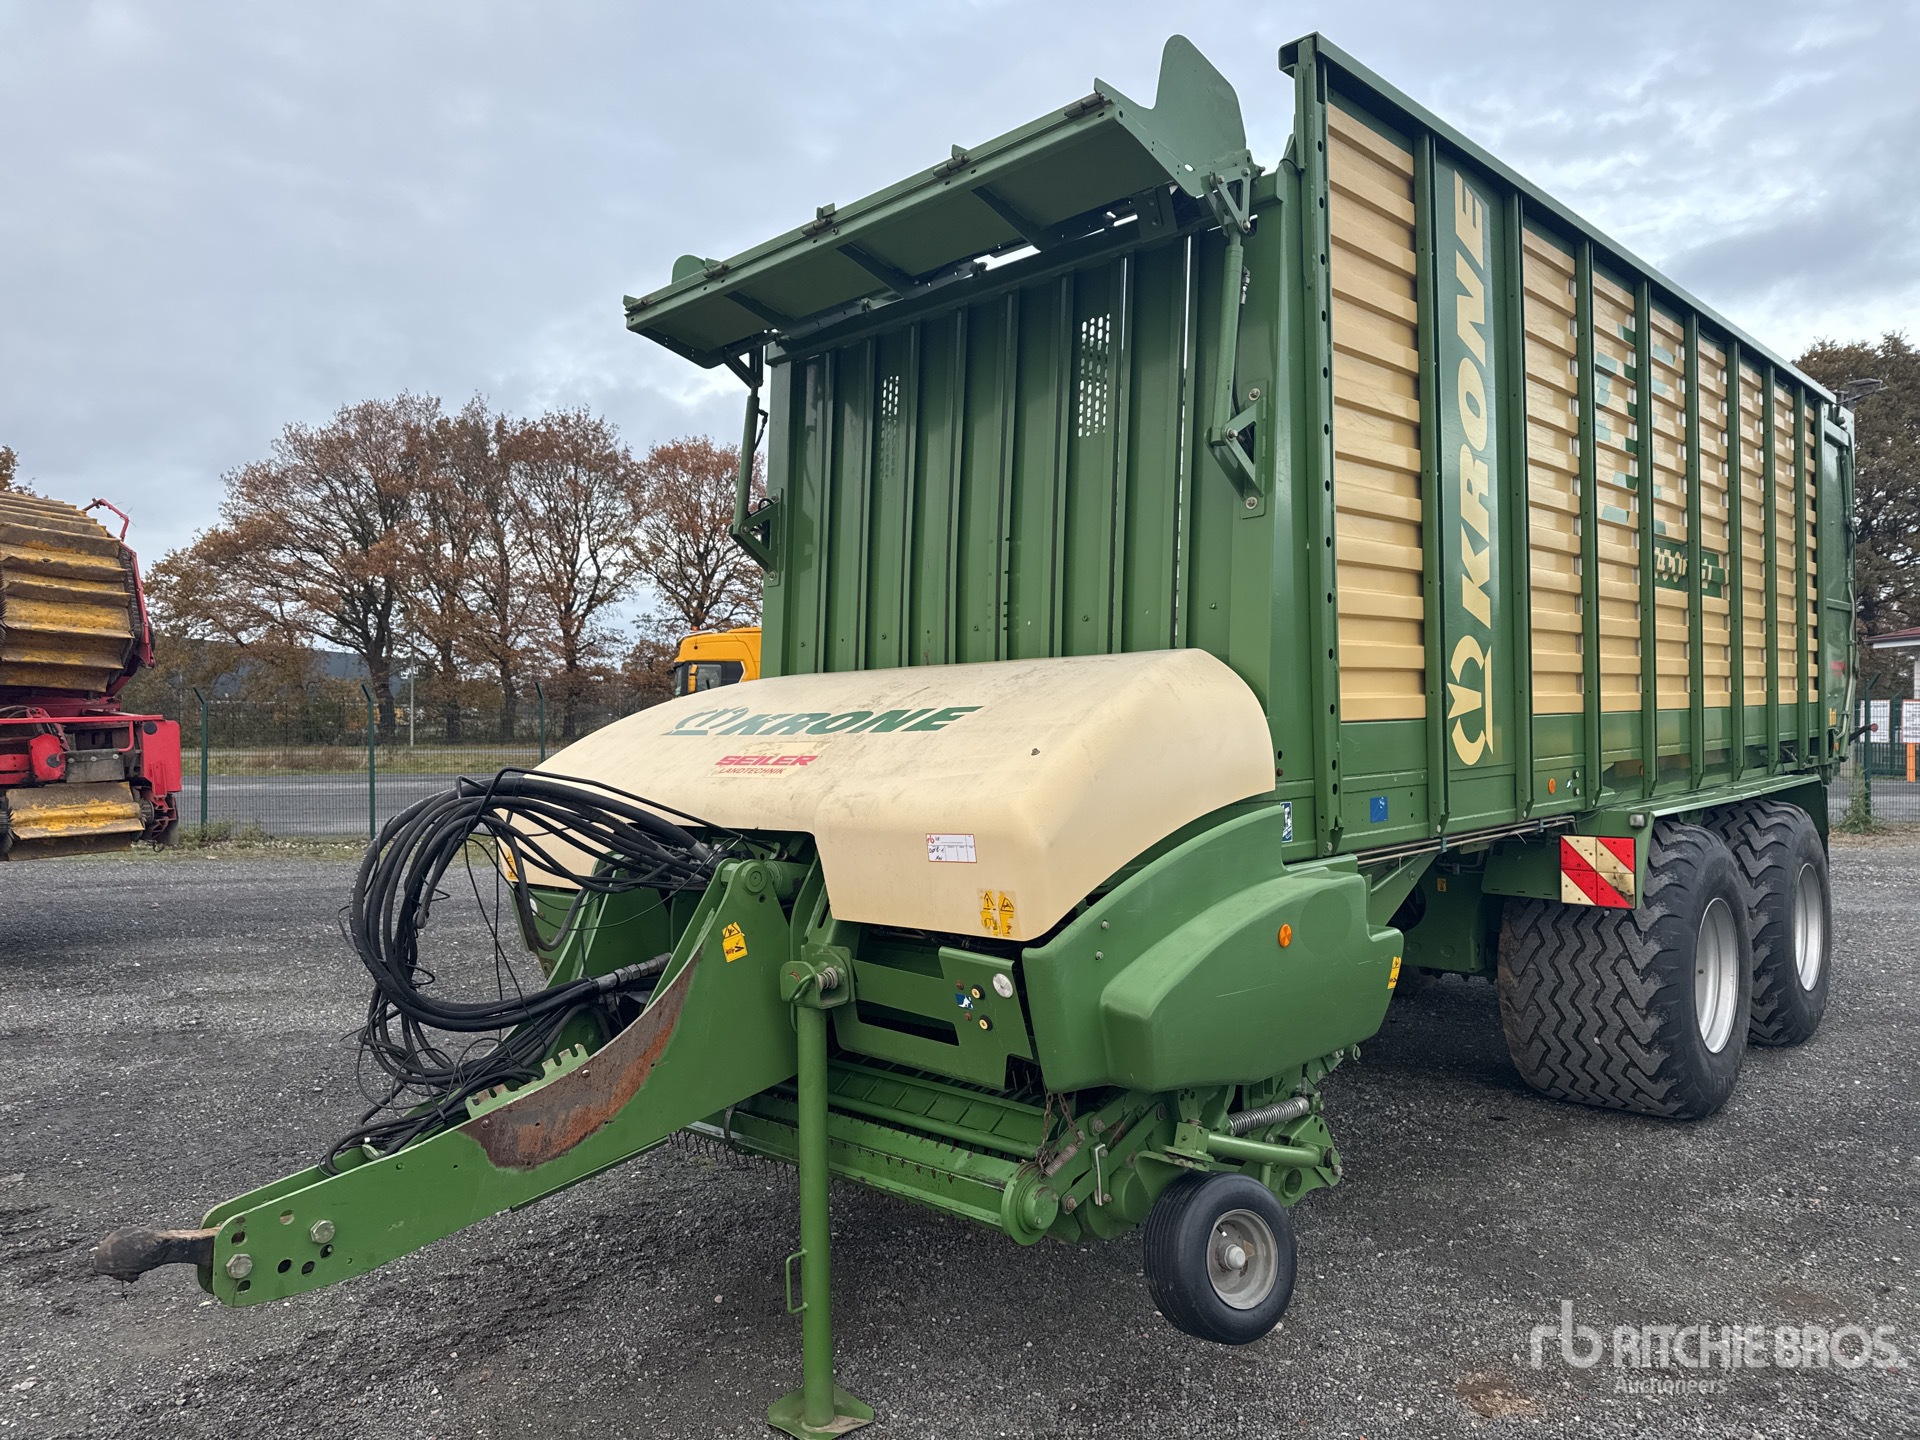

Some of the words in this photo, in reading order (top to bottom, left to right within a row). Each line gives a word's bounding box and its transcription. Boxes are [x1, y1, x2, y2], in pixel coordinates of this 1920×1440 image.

[1453, 168, 1493, 629] KRONE
[716, 706, 985, 736] KRONE
[715, 755, 818, 766] SEILER
[718, 767, 786, 775] LANDTECHNIK
